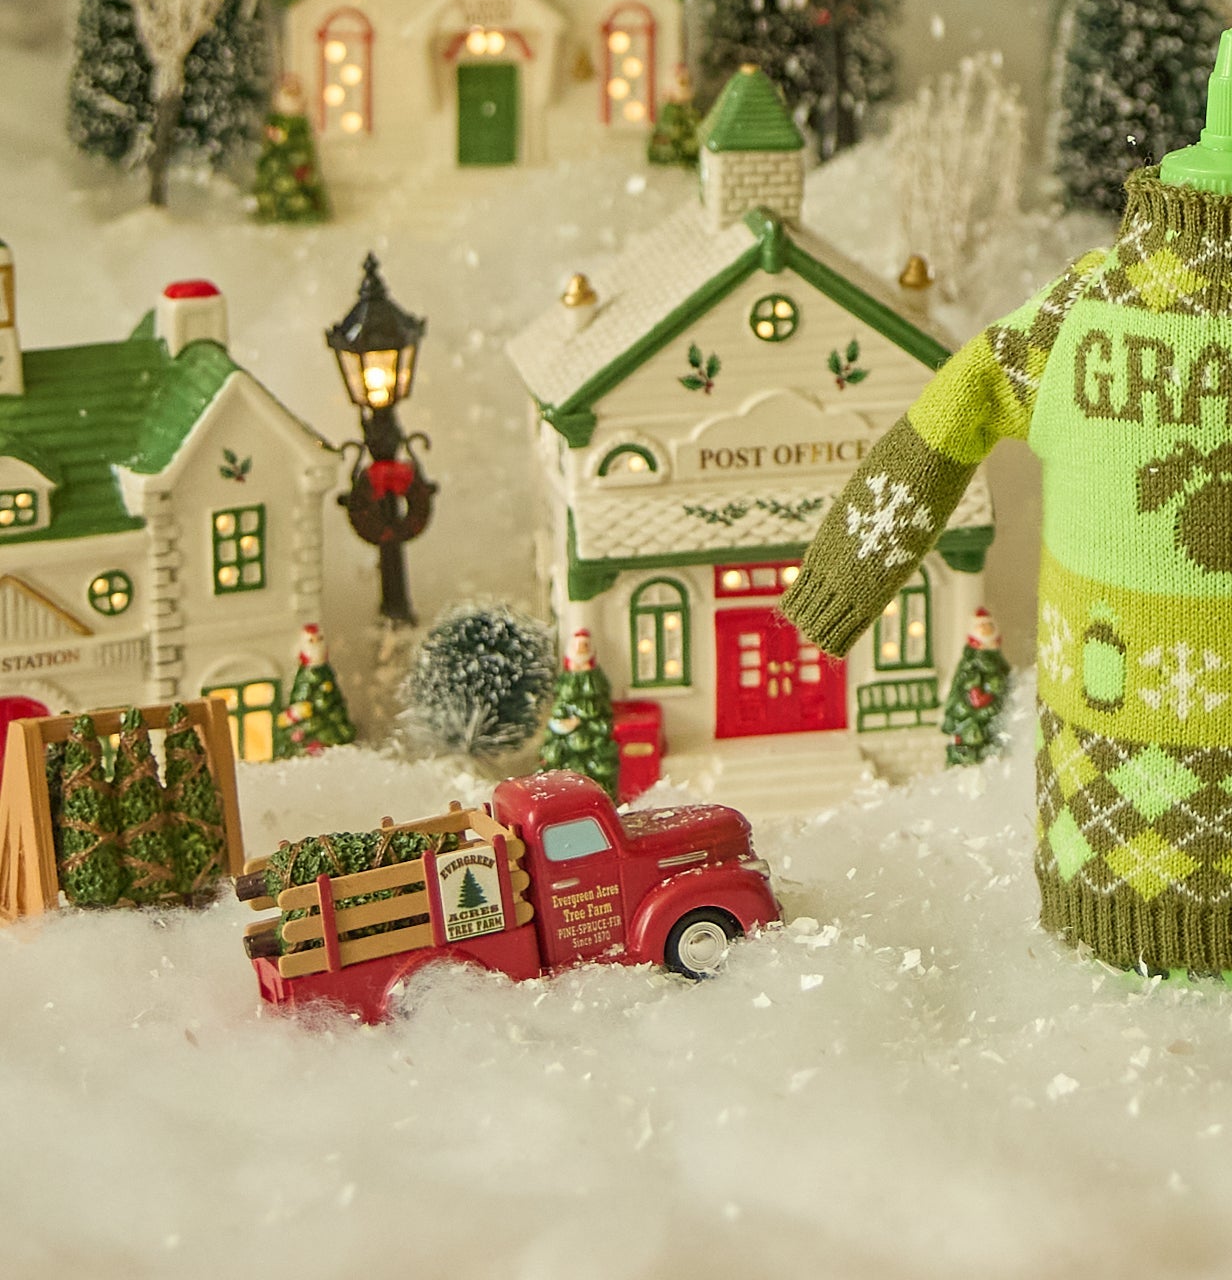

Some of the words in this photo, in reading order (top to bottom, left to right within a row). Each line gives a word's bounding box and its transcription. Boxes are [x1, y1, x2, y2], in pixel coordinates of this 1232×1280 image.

[699, 446, 766, 470] POST
[773, 439, 870, 466] OFFICE
[2, 648, 80, 673] STATION
[440, 854, 496, 880] EVERGREEN
[552, 889, 595, 908] Evergreen
[596, 884, 619, 899] Acres
[448, 904, 499, 922] ACRES
[563, 909, 586, 923] Tree
[587, 903, 613, 918] Farm
[448, 922, 474, 937] TREE
[476, 916, 503, 931] FARM
[558, 915, 622, 940] PINE-SPRUCE-FIR
[572, 936, 593, 948] Since
